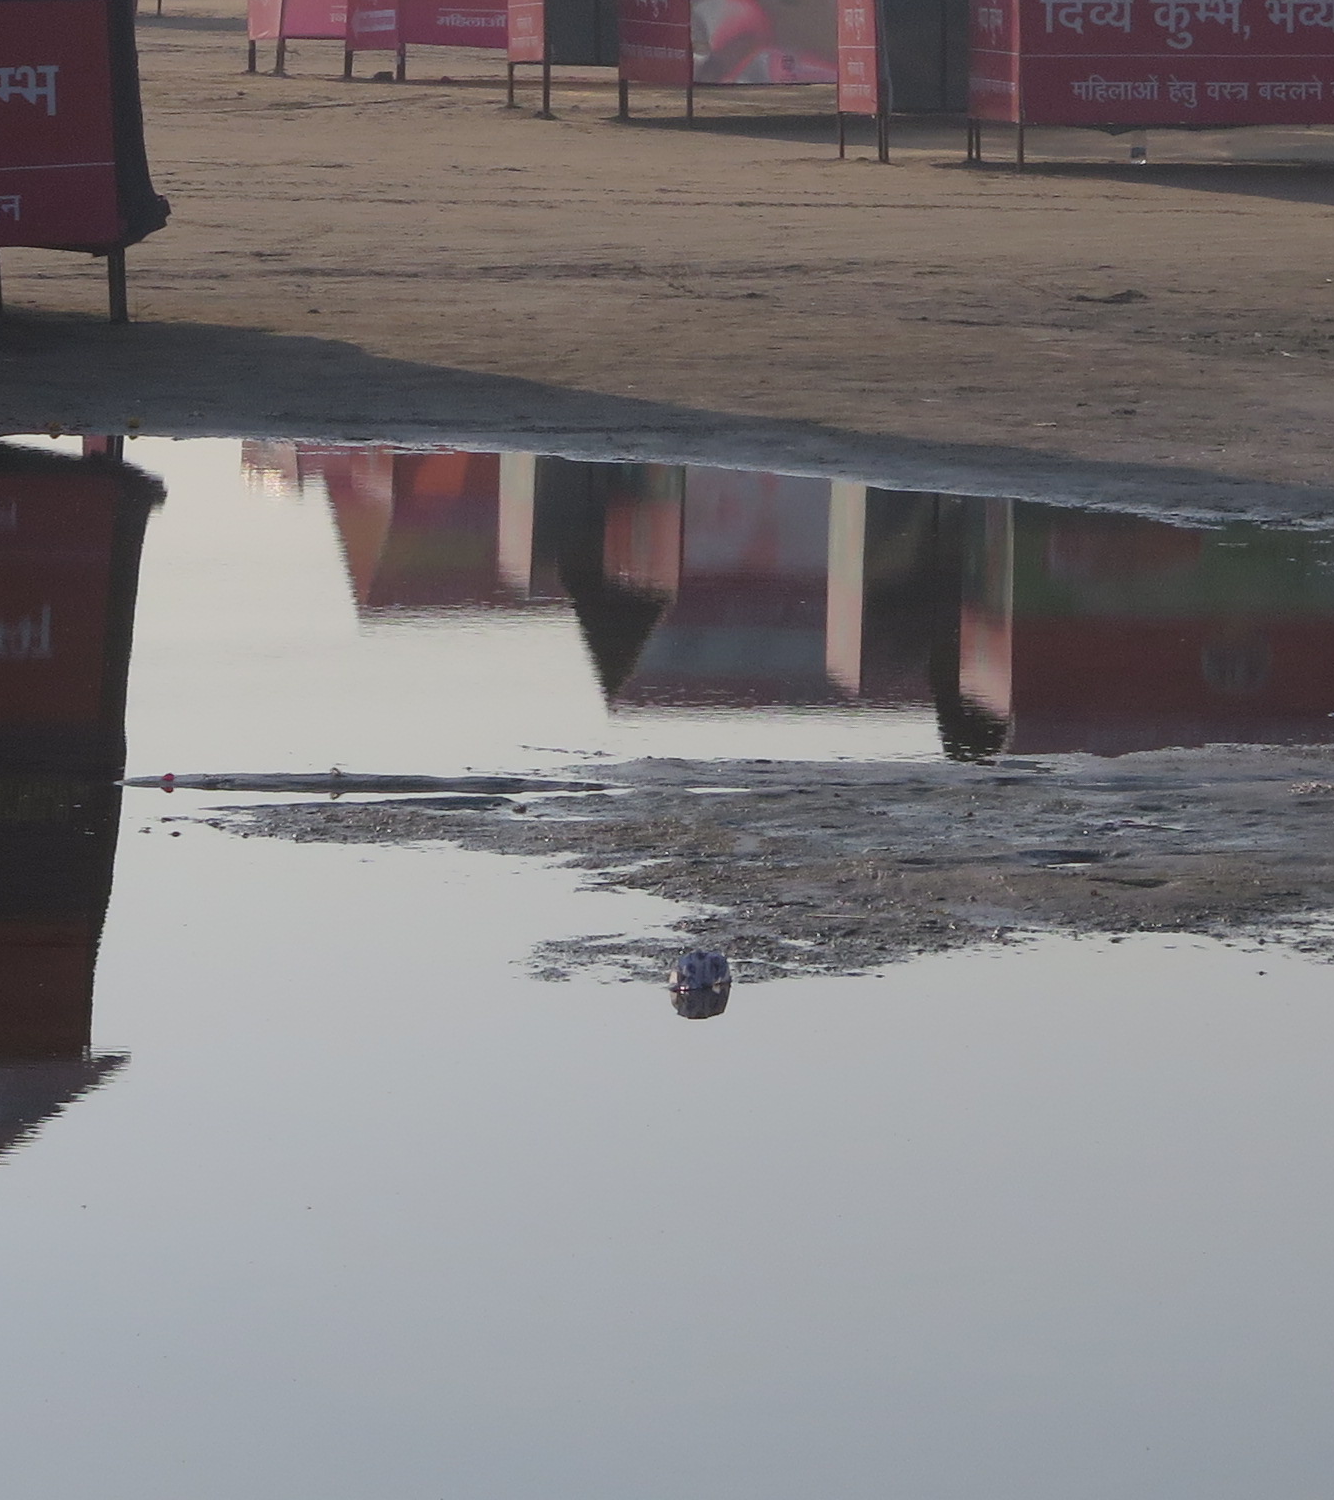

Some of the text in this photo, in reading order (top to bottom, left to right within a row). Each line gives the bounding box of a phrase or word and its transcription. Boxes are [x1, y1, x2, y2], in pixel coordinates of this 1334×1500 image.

[1070, 74, 1159, 101] महिलाओं
[1169, 75, 1198, 108] हेतु
[1205, 81, 1249, 102] वस्त्र
[1257, 74, 1323, 100] बदलने
